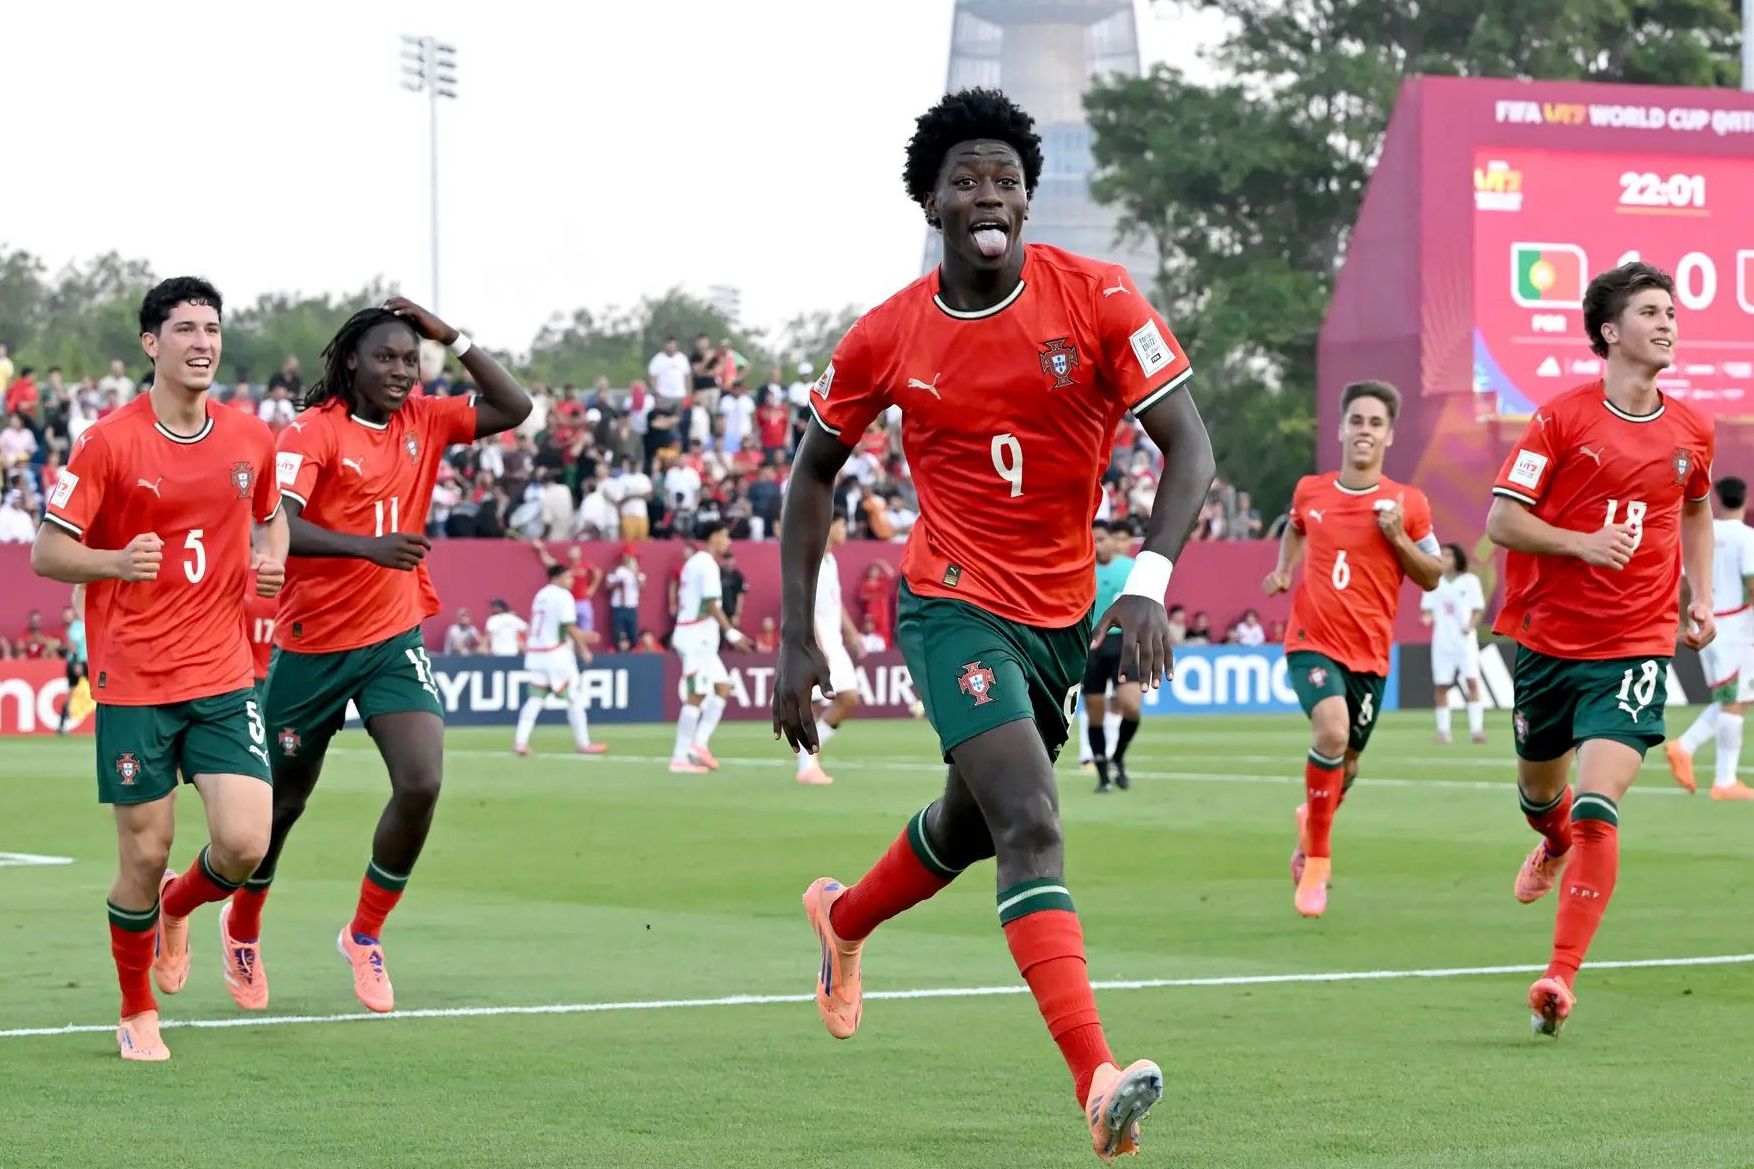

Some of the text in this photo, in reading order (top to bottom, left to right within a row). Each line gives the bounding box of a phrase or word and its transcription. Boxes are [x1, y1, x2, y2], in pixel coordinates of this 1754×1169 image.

[1496, 101, 1542, 124] FIFA
[1589, 104, 1665, 129] WORLD
[1667, 108, 1710, 130] CUP
[1619, 172, 1705, 207] 22:01
[1676, 252, 1717, 310] 0
[990, 433, 1024, 498] 9
[375, 496, 399, 537] 11
[1604, 499, 1647, 554] 18
[183, 529, 206, 584] 5
[1332, 550, 1351, 590] 6
[254, 617, 276, 644] 17
[1616, 660, 1658, 706] 18
[246, 701, 265, 744] 5
[1357, 693, 1373, 725] 6
